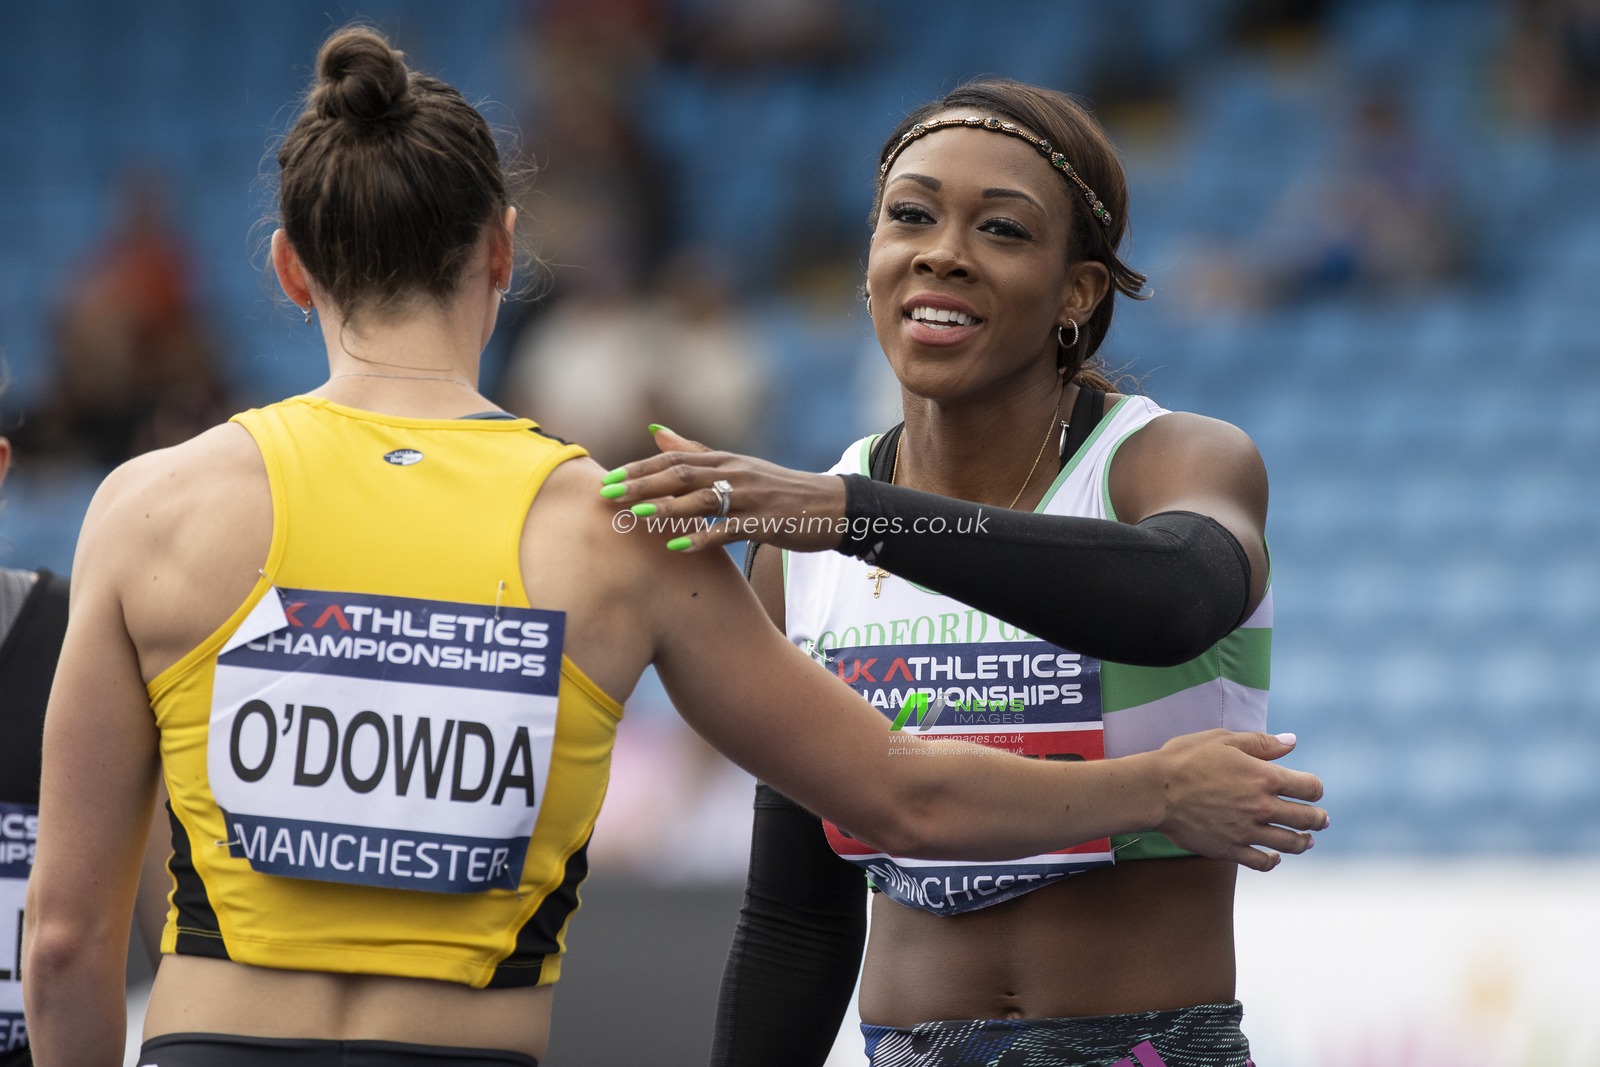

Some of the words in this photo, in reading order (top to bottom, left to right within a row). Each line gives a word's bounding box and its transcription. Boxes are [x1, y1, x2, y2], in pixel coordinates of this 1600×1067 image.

[311, 604, 550, 650] ATHLETICS
[837, 657, 878, 683] UK
[882, 653, 1082, 683] ATHLETICS
[228, 698, 536, 808] O'DOWDA
[233, 822, 510, 884] MANCHESTER
